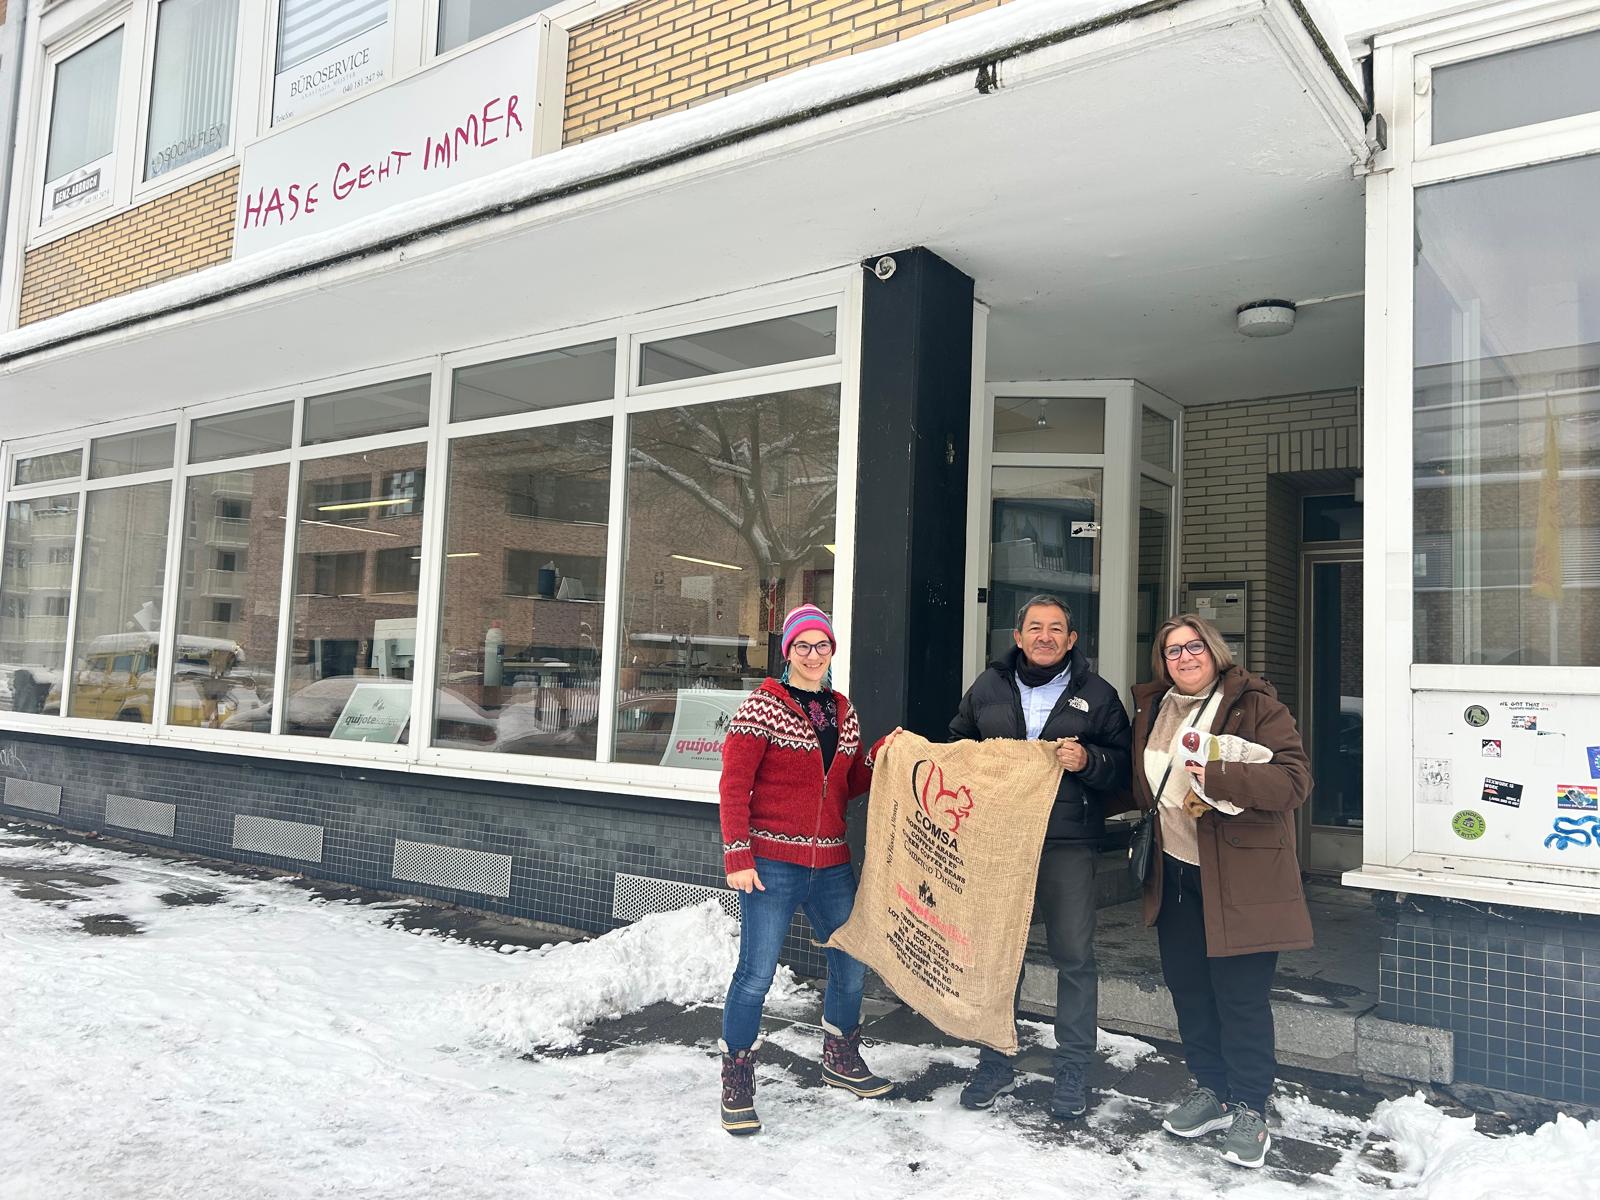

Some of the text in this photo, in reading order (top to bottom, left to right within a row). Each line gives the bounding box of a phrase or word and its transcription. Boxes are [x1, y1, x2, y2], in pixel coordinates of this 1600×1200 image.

[289, 47, 370, 97] BÜROSERVICE
[243, 94, 523, 229] HASE GEHT IMMER
[914, 810, 959, 853] COMSA
[934, 867, 964, 896] Directo
